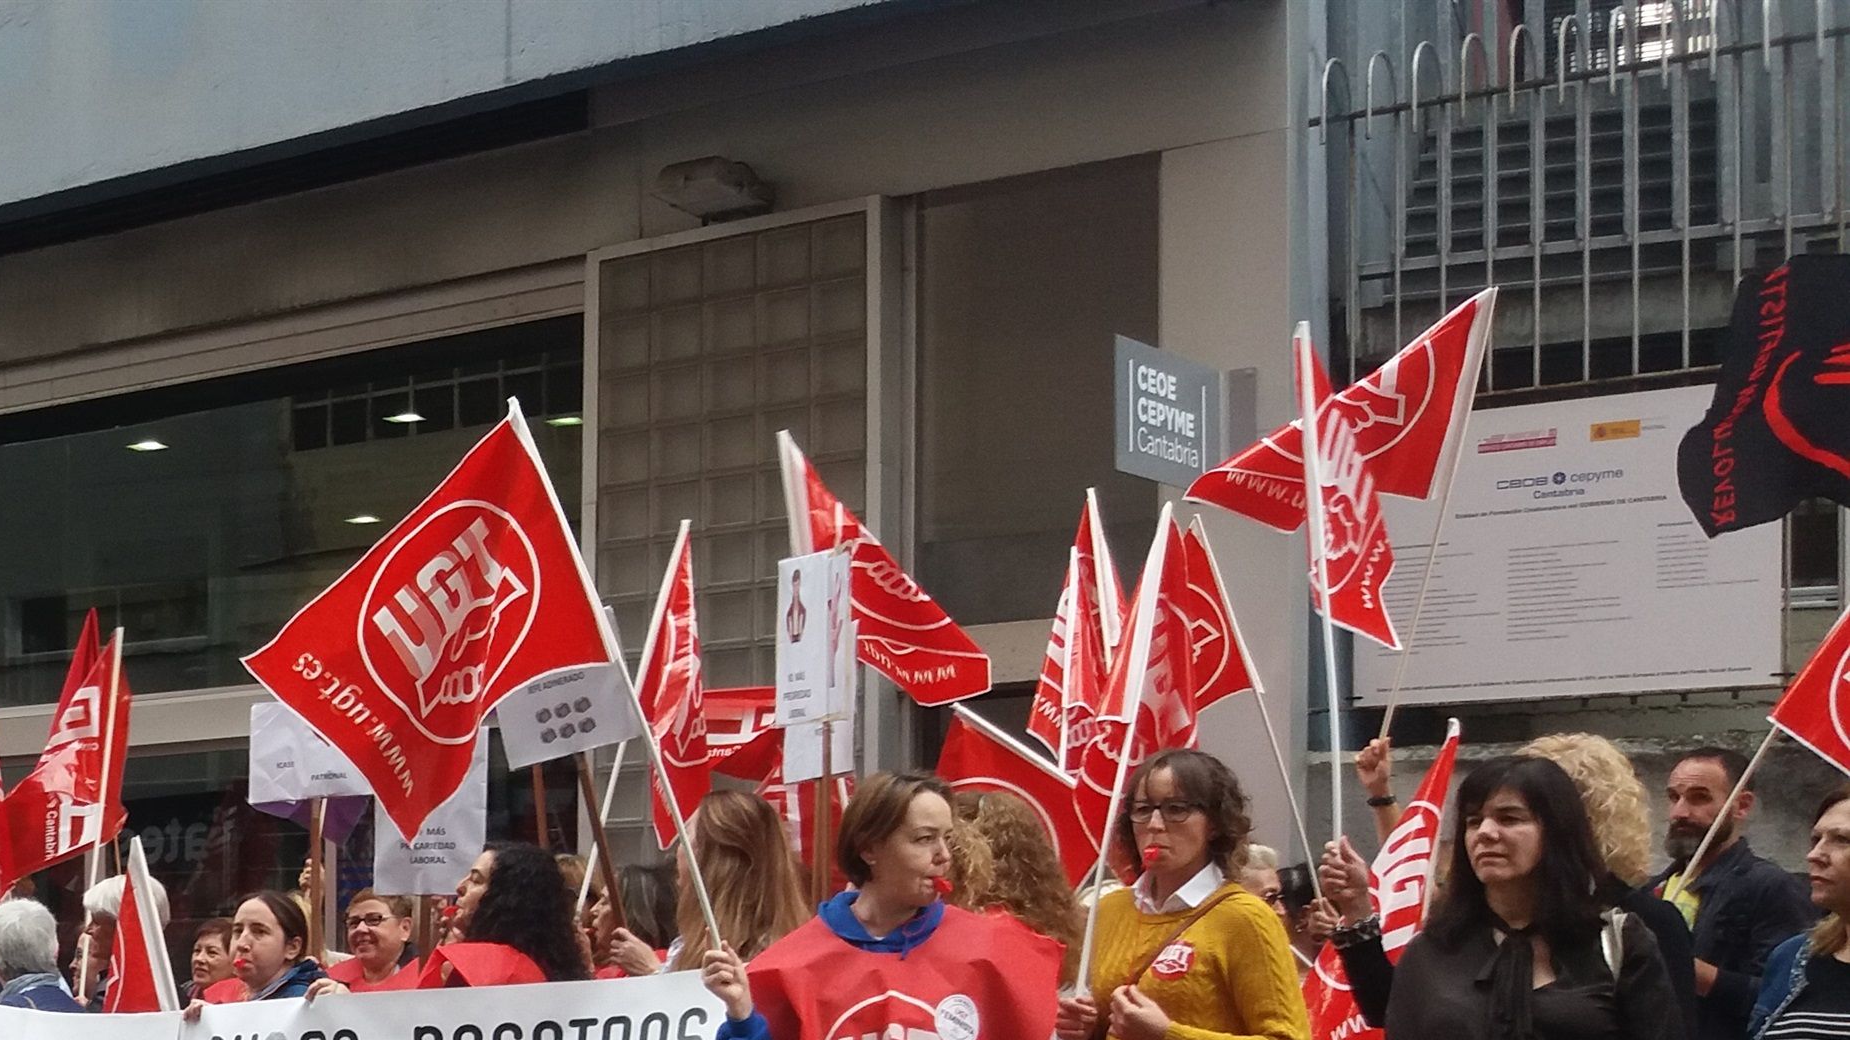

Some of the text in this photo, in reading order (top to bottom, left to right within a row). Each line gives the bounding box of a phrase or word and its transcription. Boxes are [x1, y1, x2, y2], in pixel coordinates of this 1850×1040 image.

[1137, 365, 1177, 401] CEOE
[1137, 397, 1195, 438] CEPYME
[1137, 427, 1199, 468] Cantabria
[1533, 487, 1586, 500] Cantabria
[373, 514, 505, 680] UGT
[291, 651, 416, 799] www.ugt.es
[400, 841, 456, 851] PRCARIEDAD
